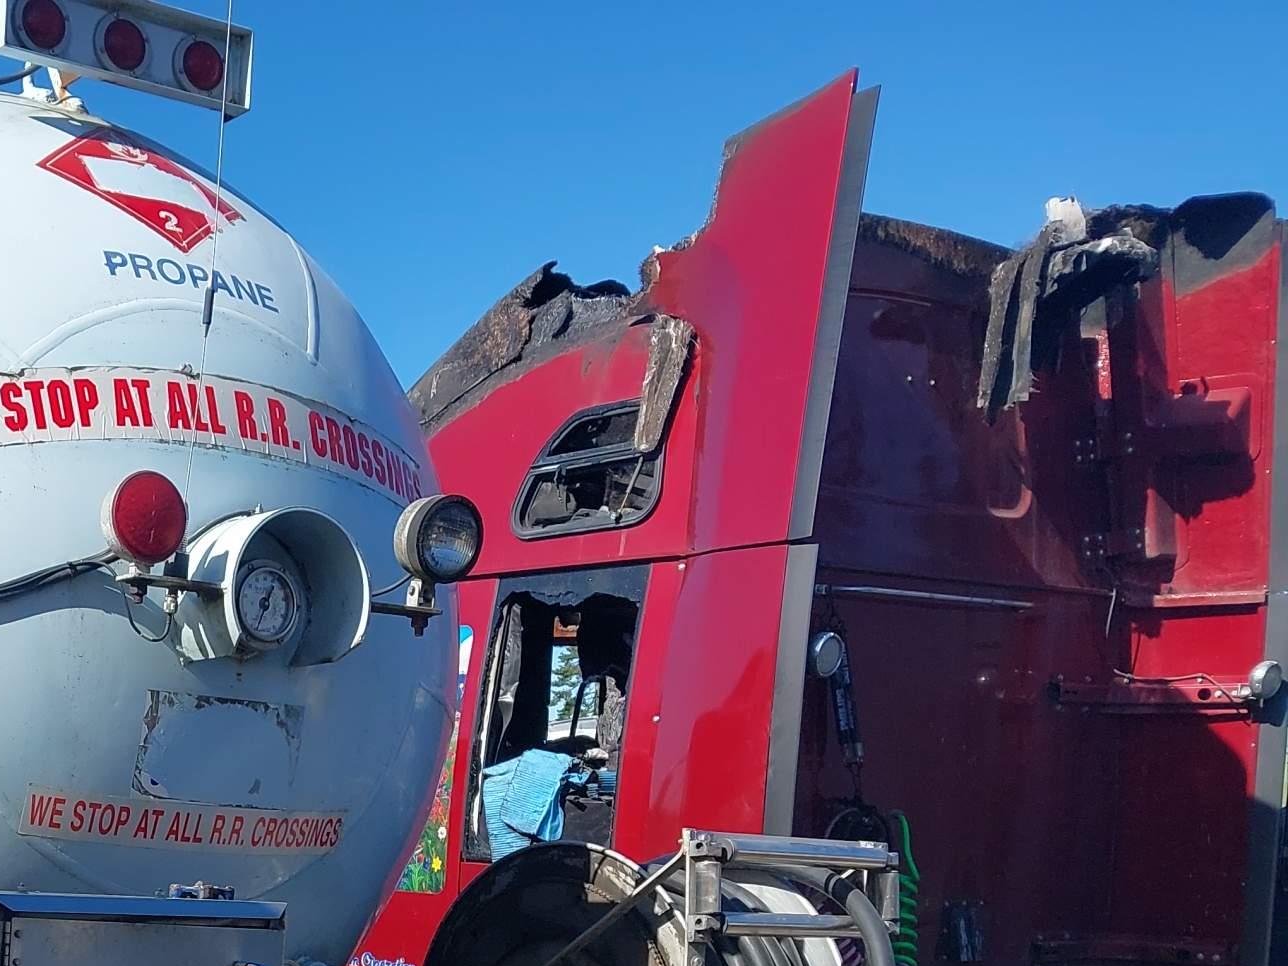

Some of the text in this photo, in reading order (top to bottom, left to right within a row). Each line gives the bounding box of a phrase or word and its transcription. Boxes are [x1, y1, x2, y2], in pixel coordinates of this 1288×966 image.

[159, 211, 183, 233] 2
[103, 250, 279, 313] PROPANE
[0, 378, 99, 432] STOP
[113, 378, 153, 427] AT
[167, 381, 226, 434] ALL
[234, 390, 300, 450] R.R.
[308, 410, 423, 504] CROSSINGS
[30, 794, 343, 848] WE STOP AT ALL R.R. CROSSINGS
